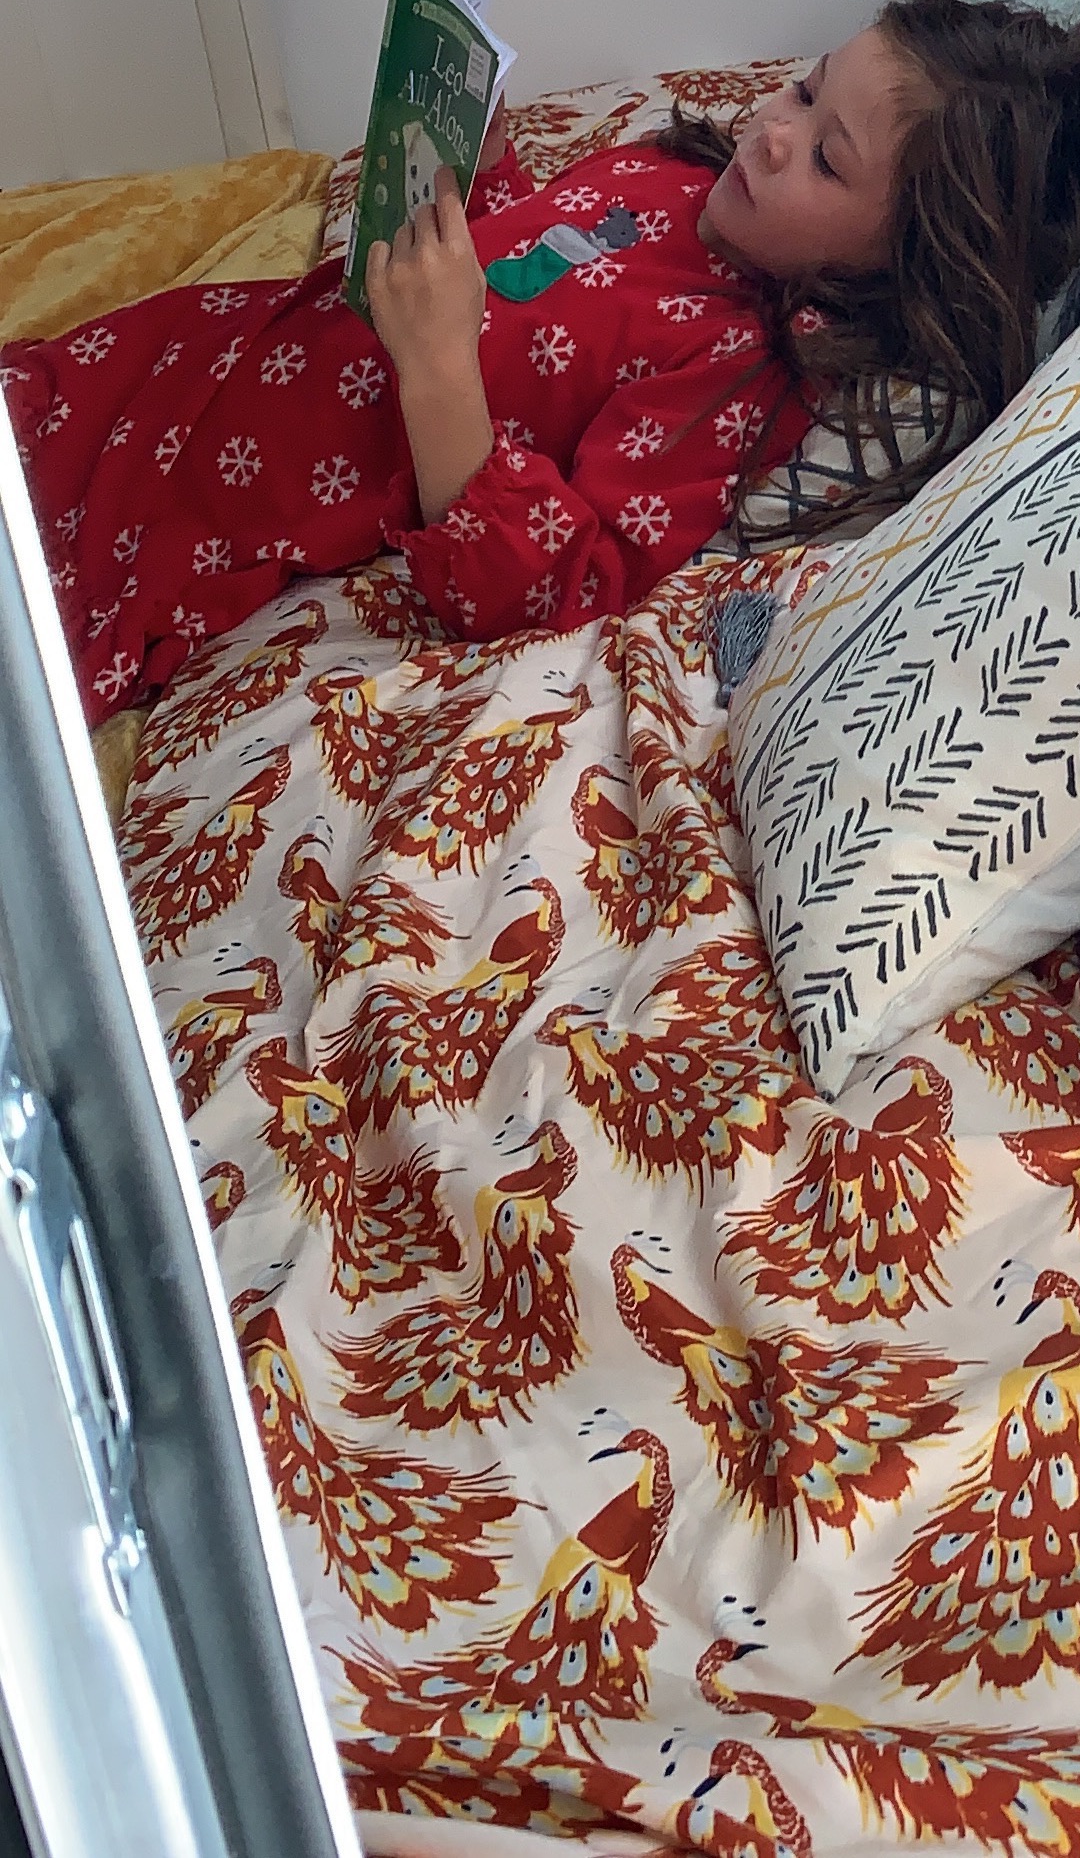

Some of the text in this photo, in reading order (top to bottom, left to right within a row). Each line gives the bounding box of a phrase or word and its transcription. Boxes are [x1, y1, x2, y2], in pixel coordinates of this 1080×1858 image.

[431, 34, 463, 96] Leo
[397, 69, 471, 166] All Alone
